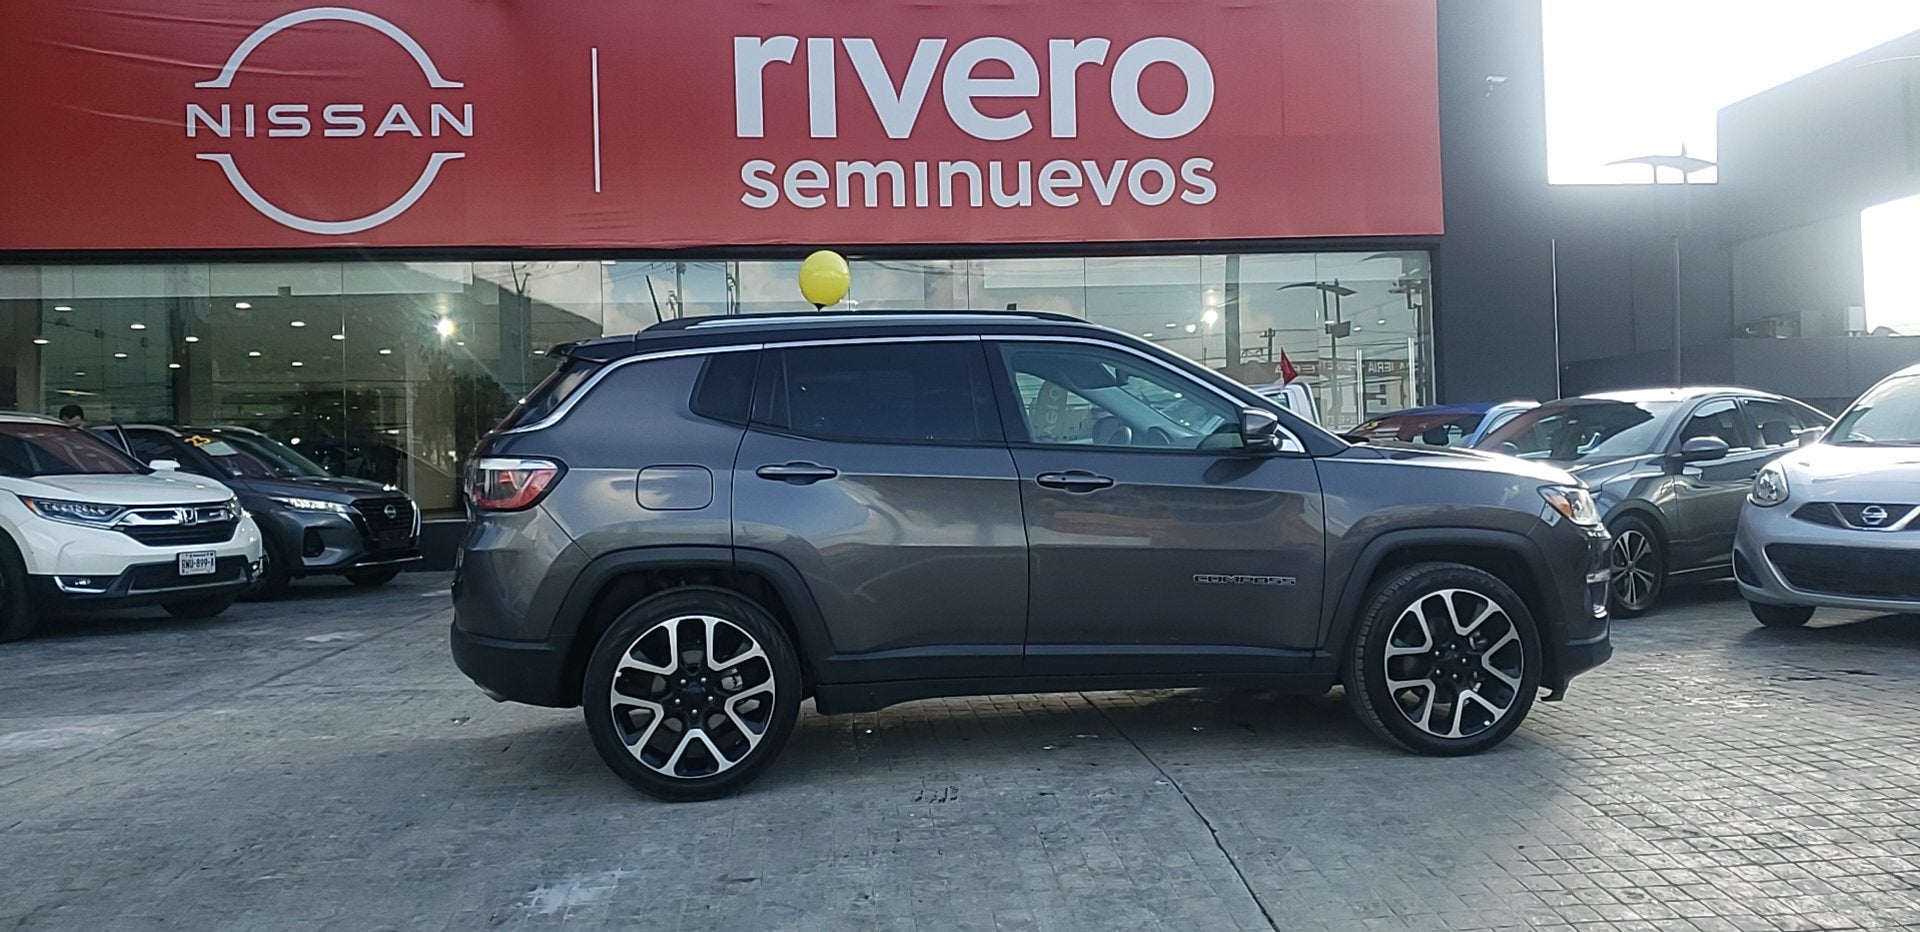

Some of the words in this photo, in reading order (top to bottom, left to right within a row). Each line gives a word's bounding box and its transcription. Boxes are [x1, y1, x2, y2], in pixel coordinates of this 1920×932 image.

[733, 35, 1215, 141] rivero
[186, 103, 473, 138] NISSAN
[740, 157, 1218, 209] seminuevos
[1193, 573, 1297, 586] COMPASS
